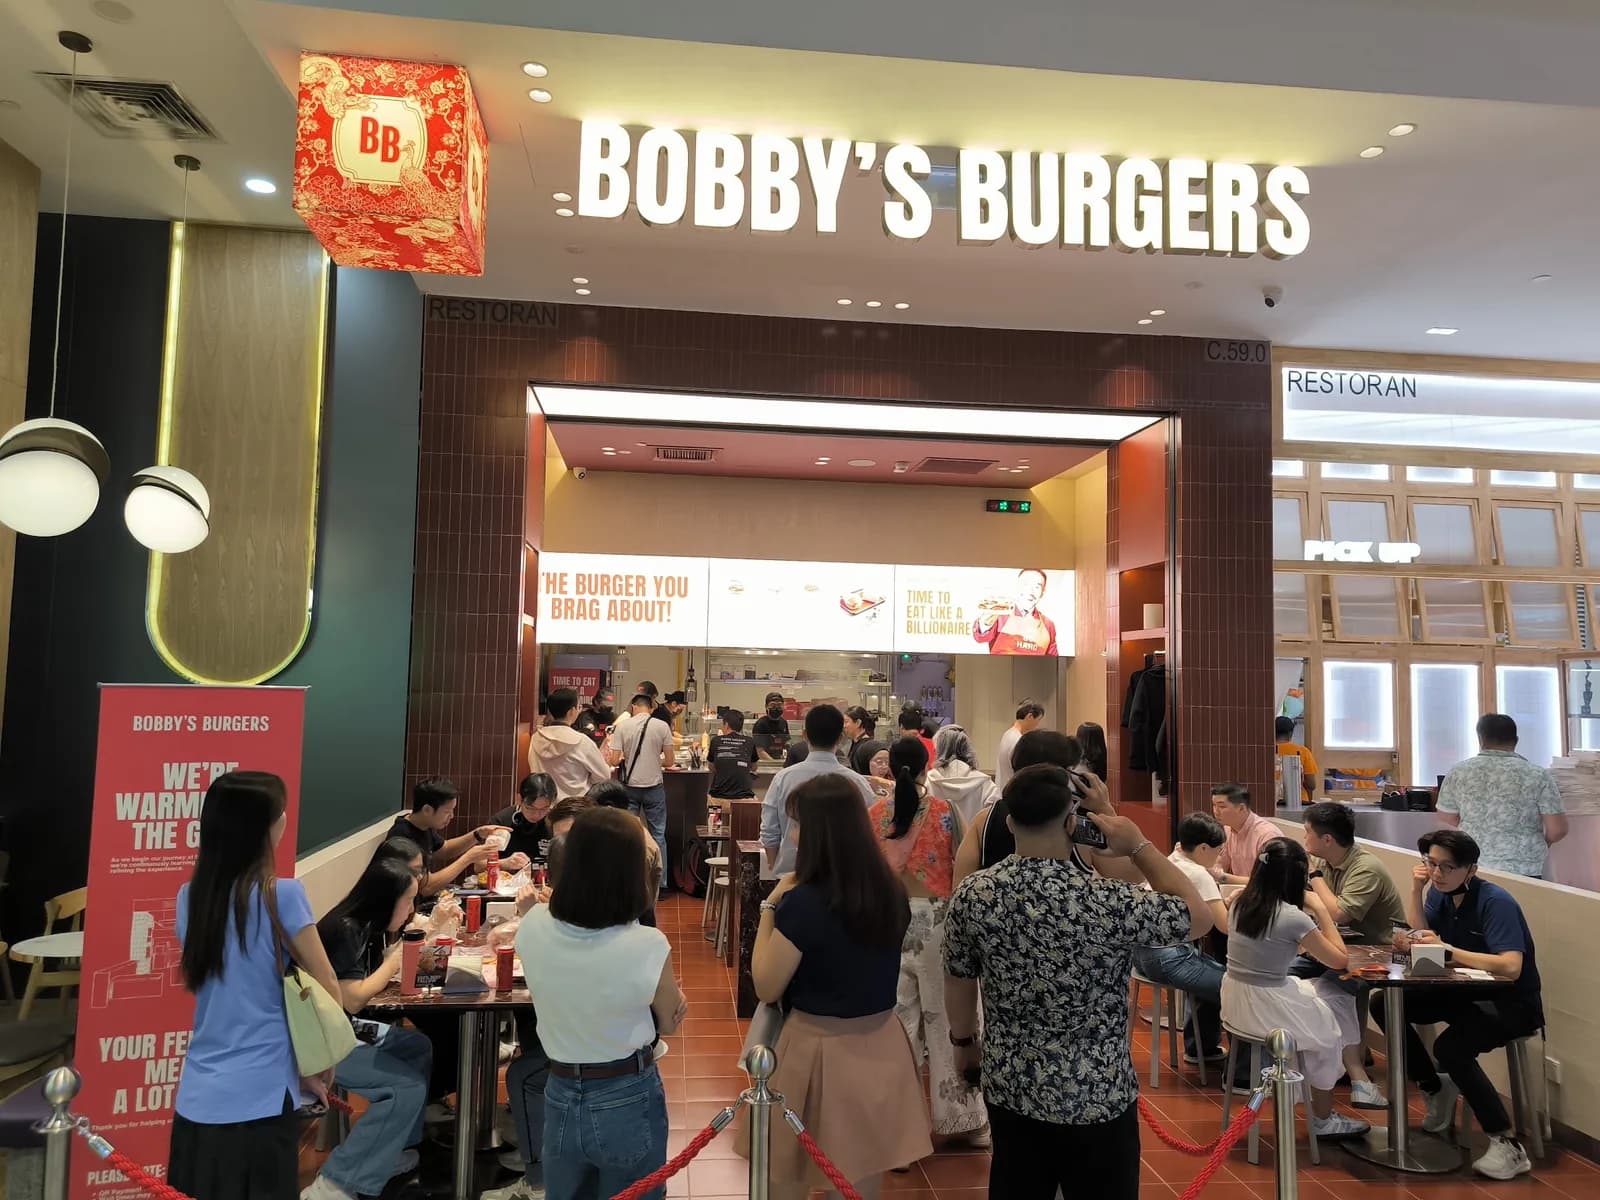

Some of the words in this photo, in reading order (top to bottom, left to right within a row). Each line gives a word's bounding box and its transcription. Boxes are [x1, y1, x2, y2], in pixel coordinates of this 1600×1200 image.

[360, 116, 400, 162] BB
[578, 118, 933, 239] BOBBY'S
[958, 149, 1311, 257] BURGERS
[429, 298, 557, 325] RESTORAN
[1207, 341, 1266, 362] C.59.0
[1288, 371, 1417, 398] RESTORAN
[1304, 540, 1374, 562] PICK
[1378, 542, 1421, 563] UP
[542, 572, 568, 595] HE
[576, 573, 646, 597] BURGER
[653, 576, 688, 598] YOU
[907, 590, 933, 603] TIME
[939, 591, 950, 605] TO
[551, 598, 600, 620] BRAG
[607, 600, 672, 622] ABOUT!
[906, 606, 926, 619] EAT
[930, 606, 952, 619] LIKE
[956, 607, 963, 620] A
[906, 621, 971, 636] BILLIONAIRE
[583, 677, 596, 686] EAT
[133, 715, 197, 732] BOBBY'S
[202, 715, 270, 732] BURGERS
[132, 822, 178, 850] THE
[99, 1033, 156, 1062] YOUR
[144, 1057, 186, 1085] ME
[113, 1088, 128, 1114] A
[135, 1084, 175, 1112] LOT
